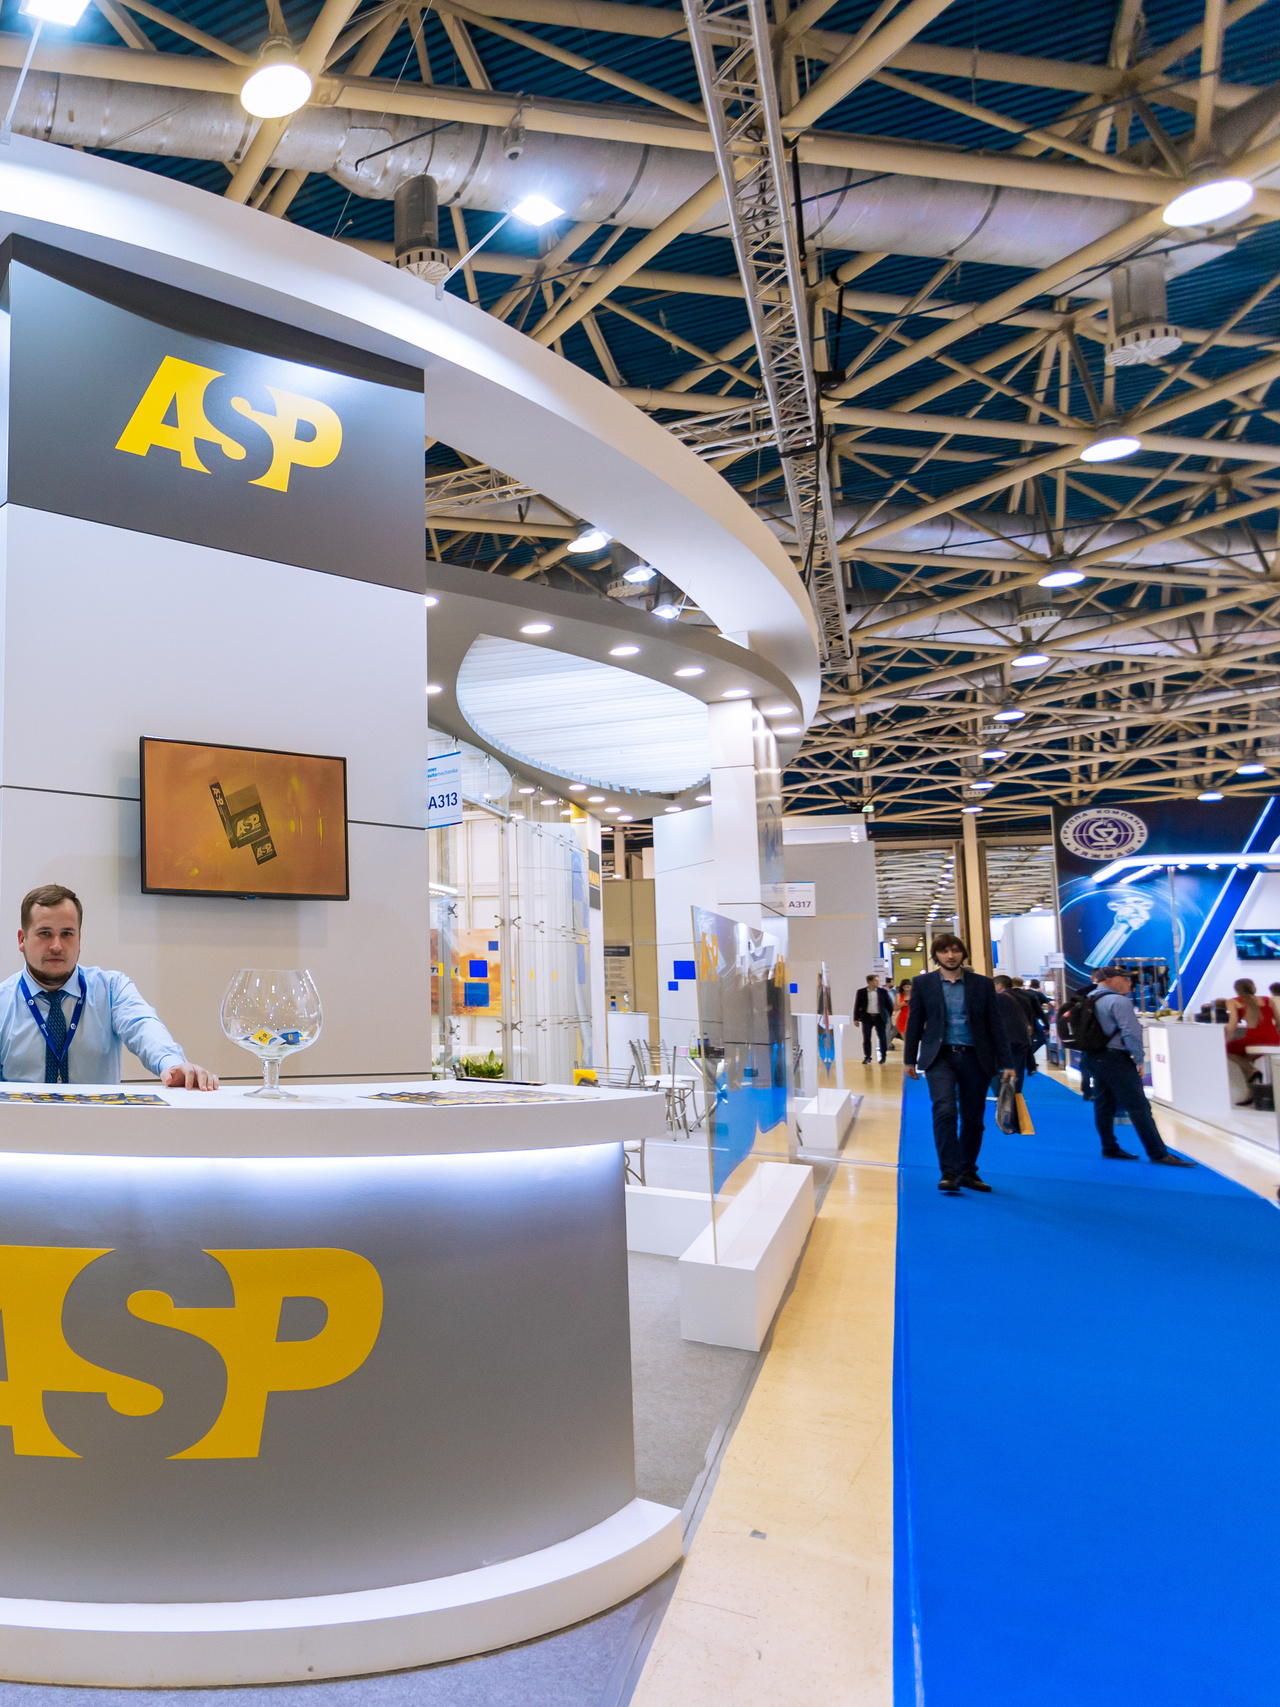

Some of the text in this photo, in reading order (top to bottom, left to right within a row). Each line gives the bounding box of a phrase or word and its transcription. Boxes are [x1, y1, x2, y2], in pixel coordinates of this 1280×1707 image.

[115, 355, 342, 492] ASP
[428, 792, 458, 810] A313
[236, 813, 260, 838] ASP
[1062, 812, 1088, 840] ГРУППА
[256, 843, 272, 858] ASP
[1073, 847, 1136, 860] ТЯЖМАШ
[788, 901, 812, 909] A317
